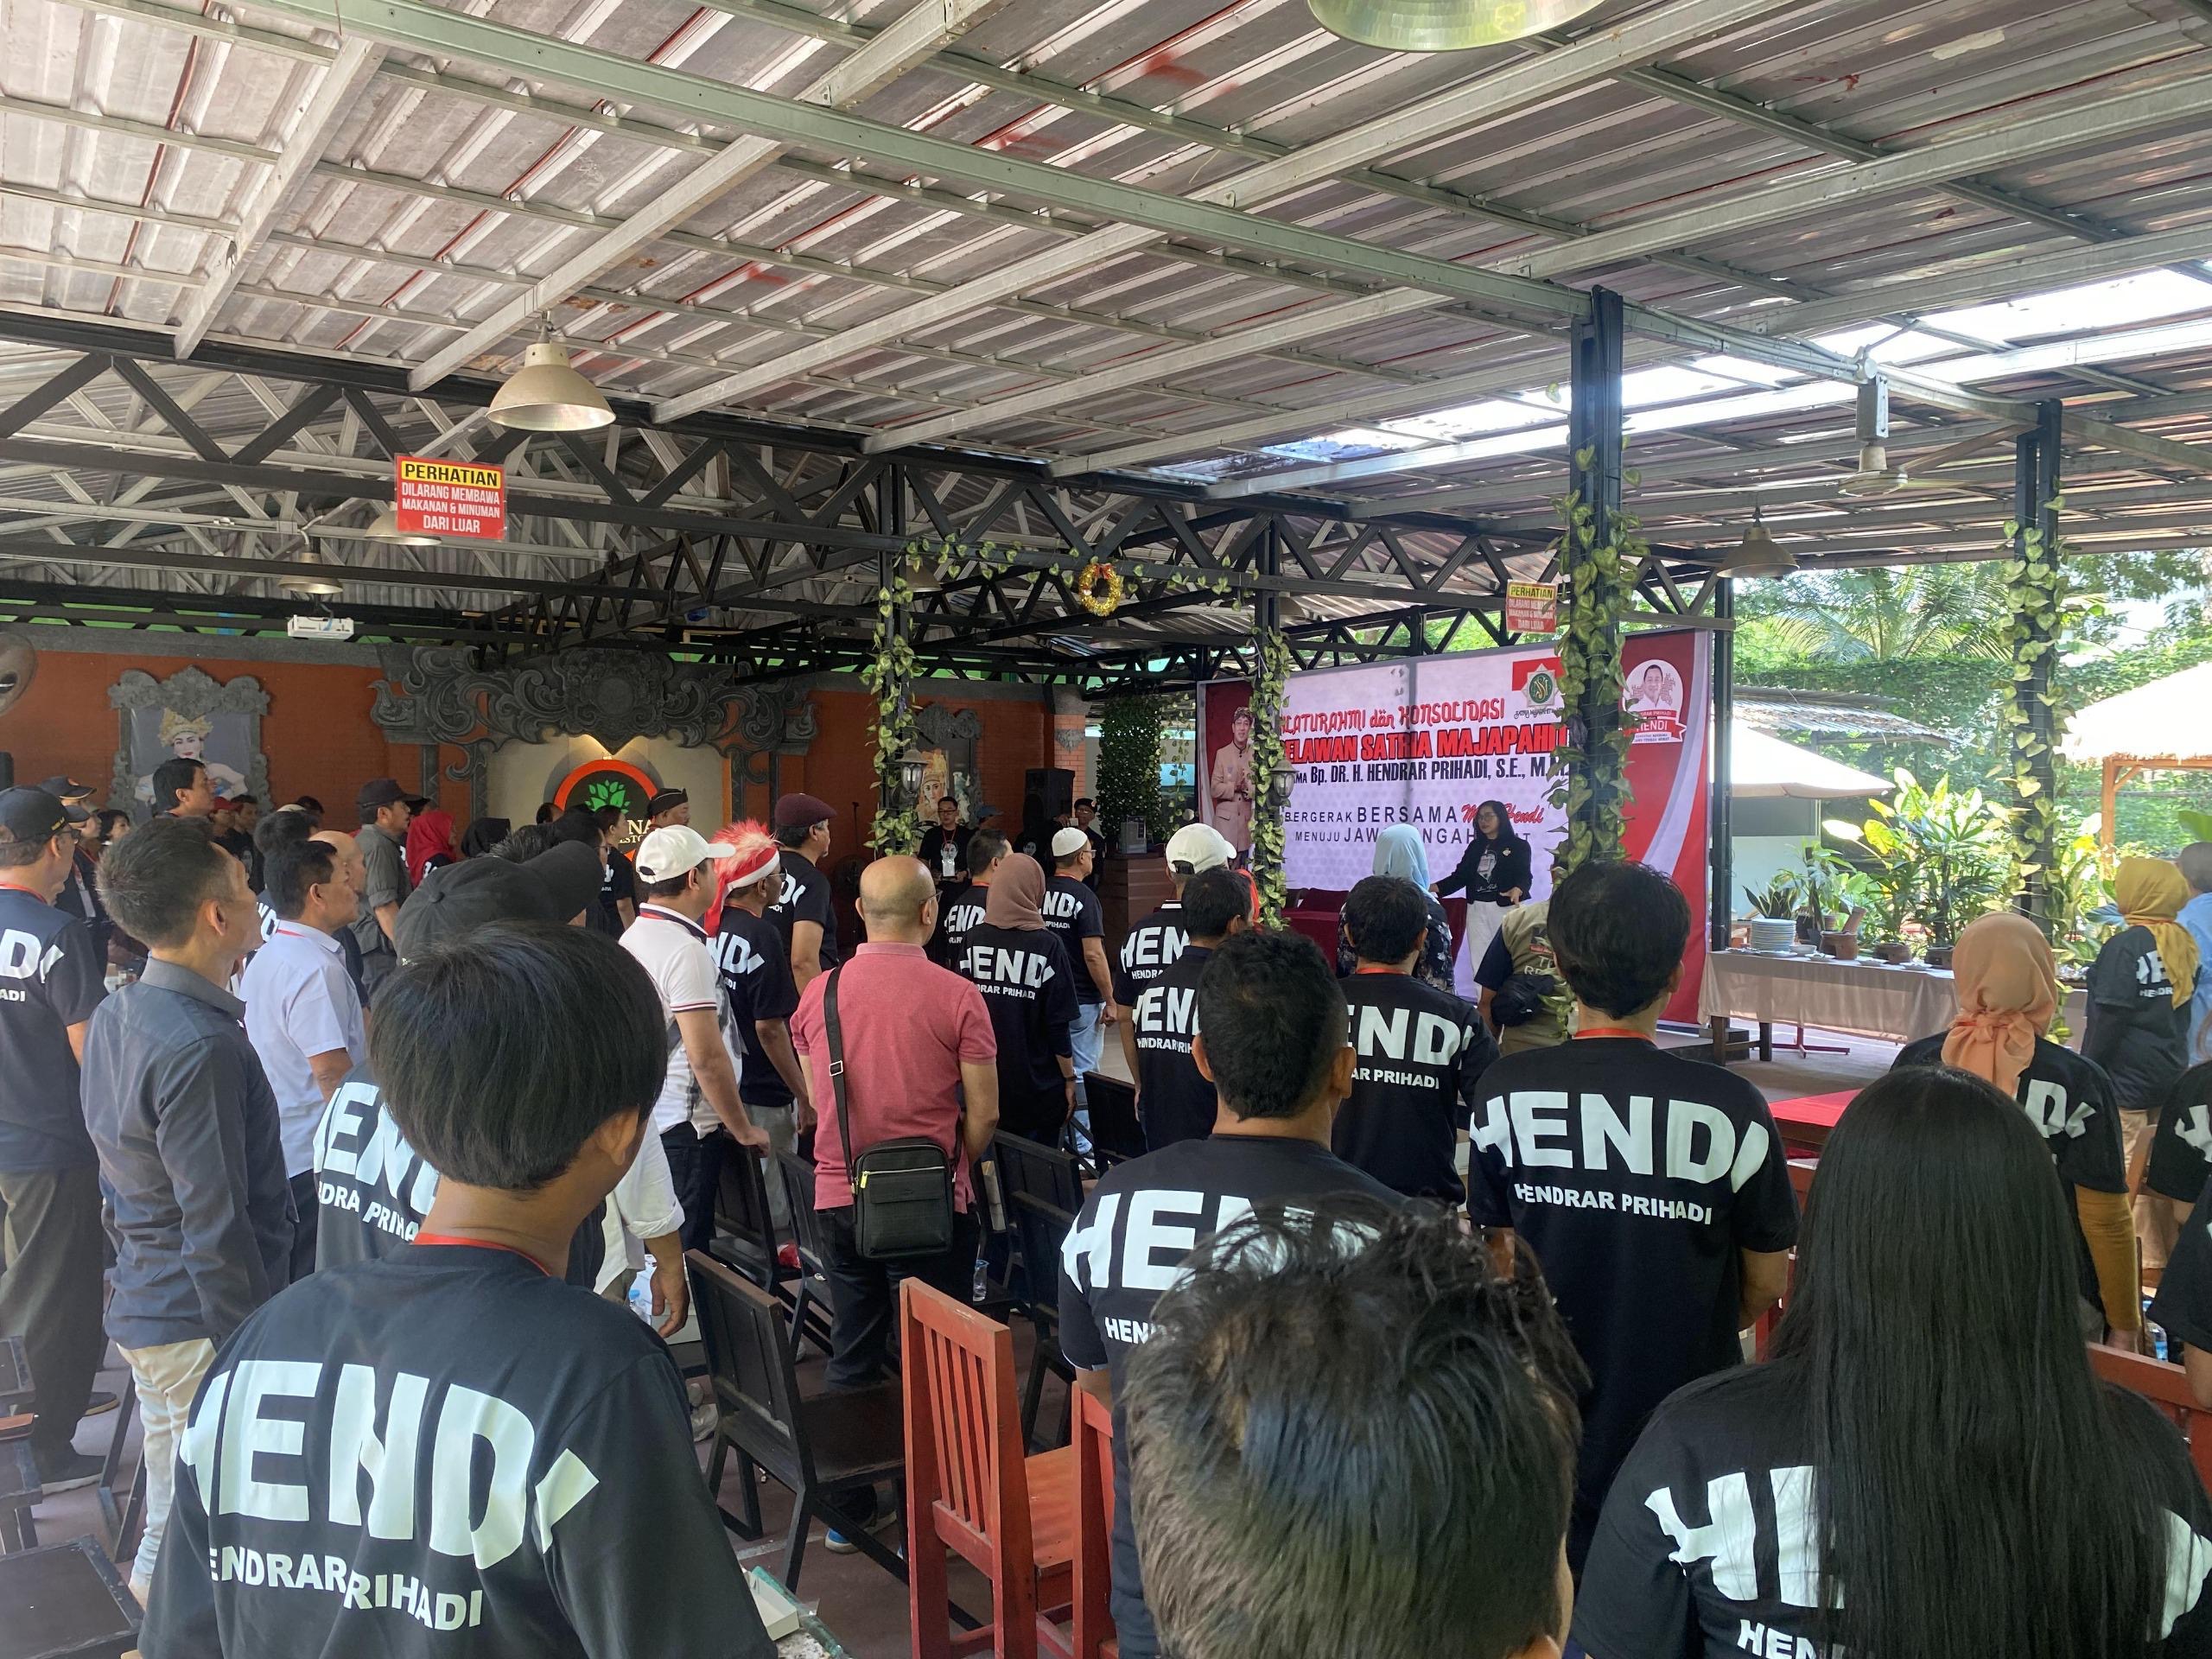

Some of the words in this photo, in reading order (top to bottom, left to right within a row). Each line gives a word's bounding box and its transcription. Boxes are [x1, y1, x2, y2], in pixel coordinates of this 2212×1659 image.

[405, 463, 498, 486] PERHATIAN
[402, 482, 448, 499] DILARANG
[451, 487, 500, 505] MEMBAWA
[402, 498, 448, 513] MAKANAN
[450, 502, 456, 514] &
[458, 504, 500, 518] MINUMAN
[423, 515, 449, 531] DARI
[452, 518, 480, 533] LUAR
[1510, 586, 1553, 599] PERHATIAN
[1398, 698, 1505, 729] KONSOLIDASI
[1281, 735, 1358, 764] ELAWAN
[1361, 729, 1433, 761] SATRIA
[1311, 766, 1327, 785] Bp.
[1331, 765, 1350, 783] DR.
[1353, 764, 1363, 782] H.
[1367, 760, 1427, 782] HENDRAR
[1431, 759, 1491, 780] PRIHADI,
[1285, 811, 1352, 823] BERGERAK
[1357, 805, 1458, 823] BERSAMA
[1295, 831, 1340, 842] MENUJU
[1344, 827, 1380, 842] JAW
[1421, 828, 1477, 844] NGAH
[1374, 1069, 1440, 1090] PRIHADI
[1514, 1182, 1617, 1211] HENDRAR
[1622, 1192, 1713, 1225] PRIHADI
[362, 1201, 420, 1243] PRIHA
[209, 1545, 346, 1594] ENDRAR
[343, 1567, 483, 1631] RIHADI
